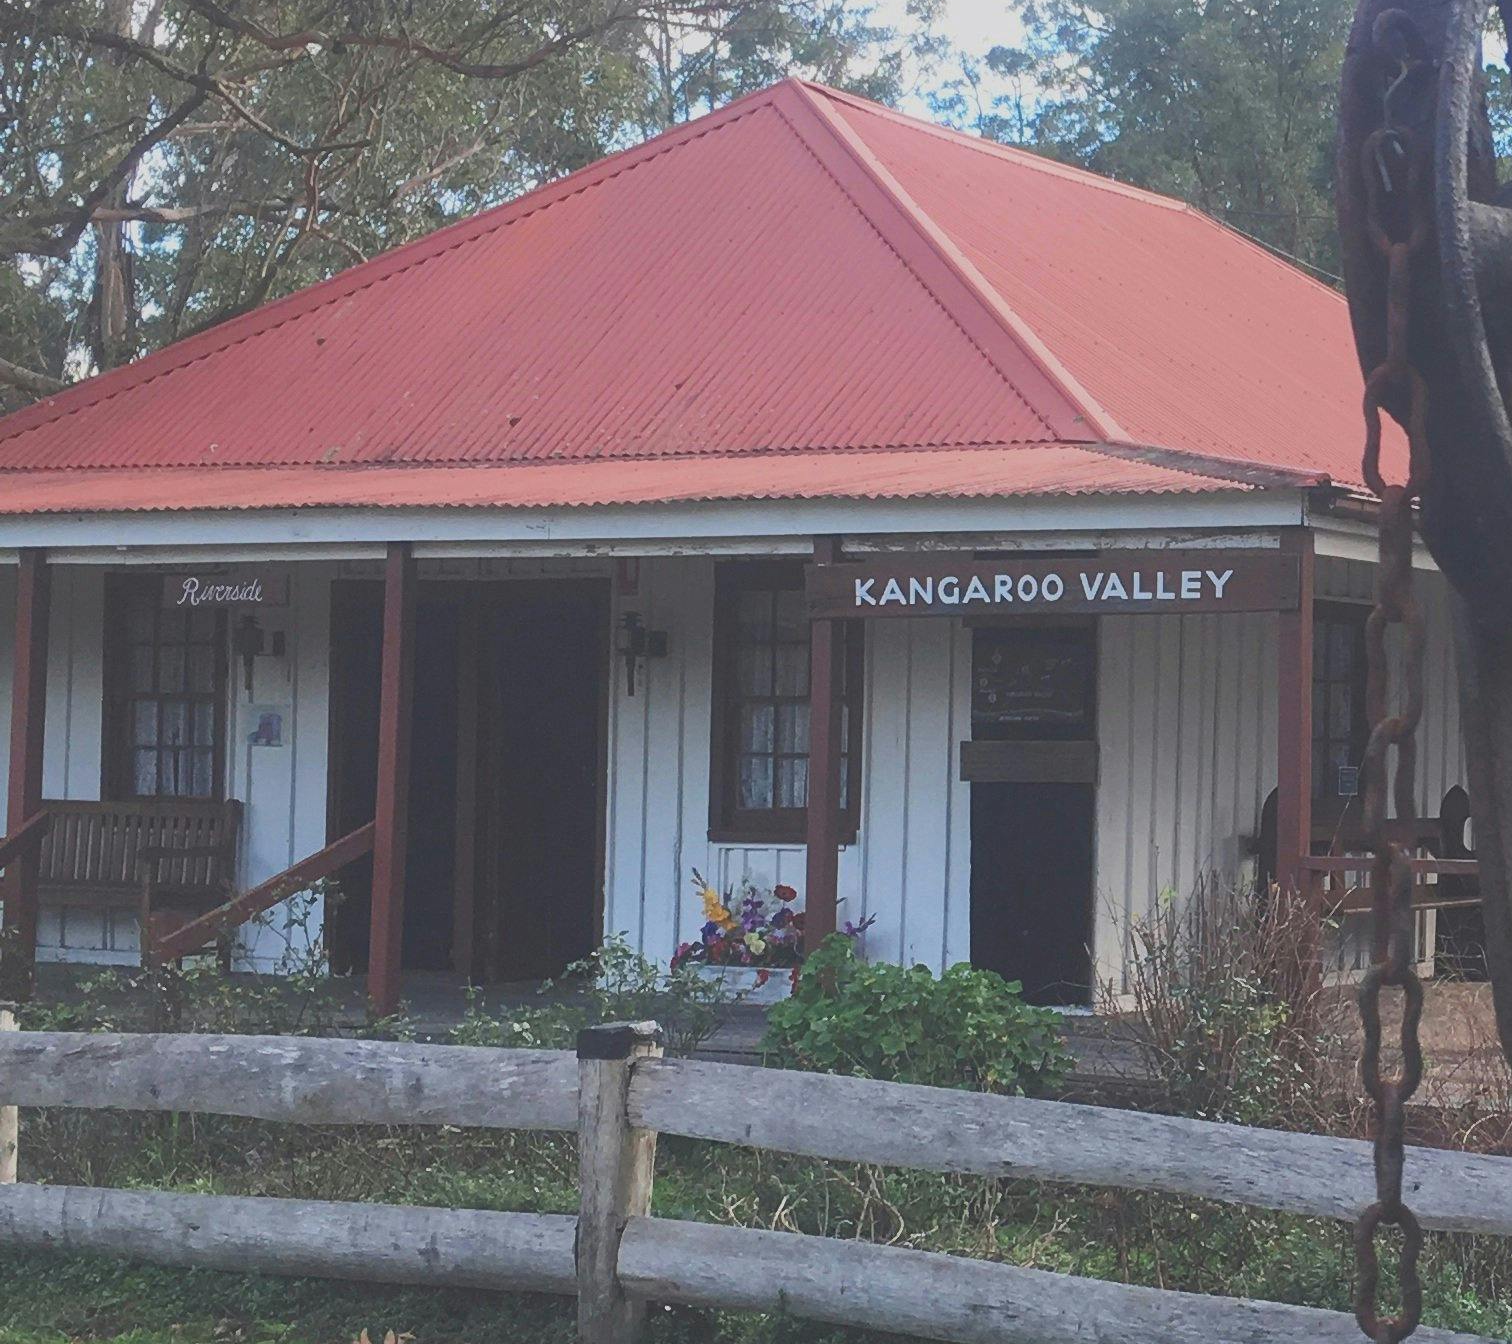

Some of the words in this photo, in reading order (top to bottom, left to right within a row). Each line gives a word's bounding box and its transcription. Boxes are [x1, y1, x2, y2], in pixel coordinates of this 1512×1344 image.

[177, 577, 263, 606] Riverside
[854, 573, 1064, 606] KANGAROO
[1080, 569, 1234, 600] VALLEY
